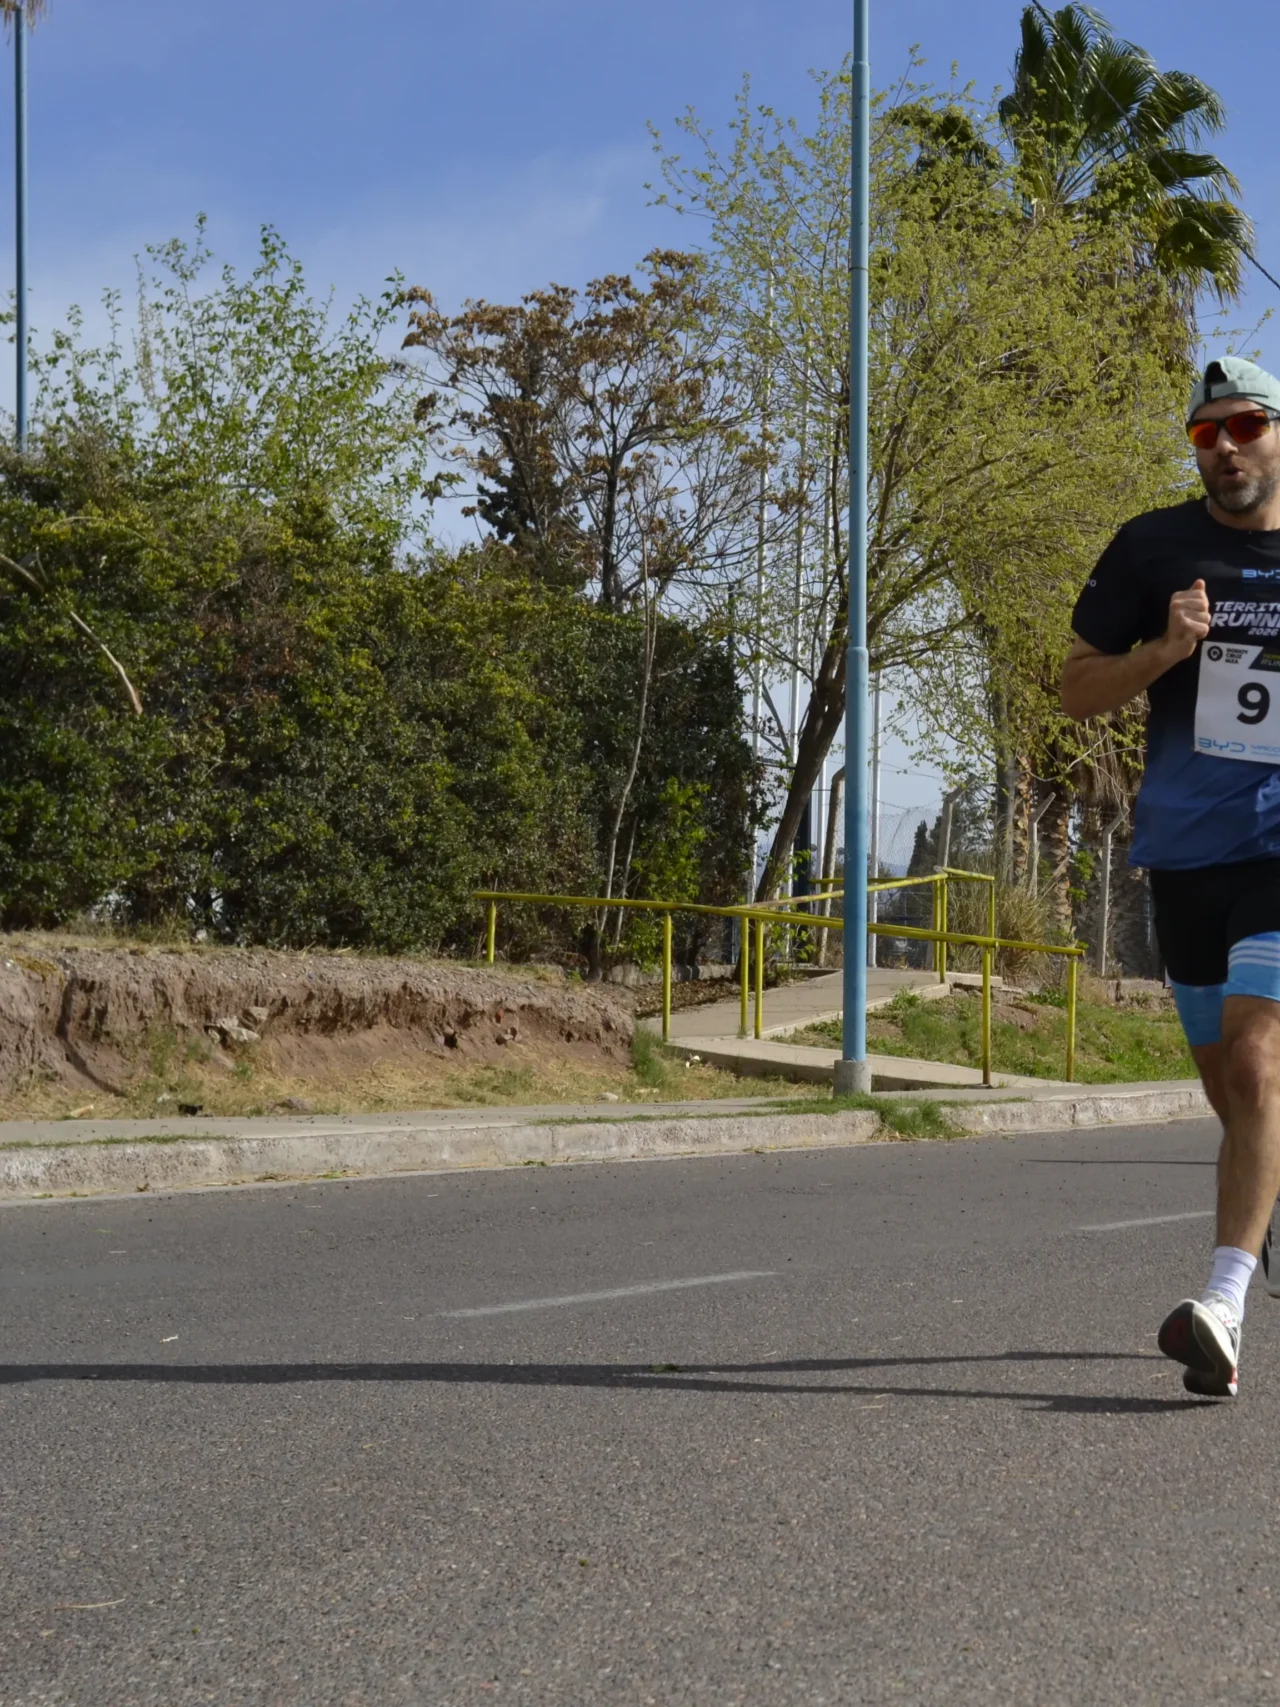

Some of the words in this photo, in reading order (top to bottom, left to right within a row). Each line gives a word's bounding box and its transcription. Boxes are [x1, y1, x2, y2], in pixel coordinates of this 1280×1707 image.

[1248, 627, 1279, 636] 2026
[1236, 681, 1271, 725] 9
[1197, 737, 1246, 753] BYD
